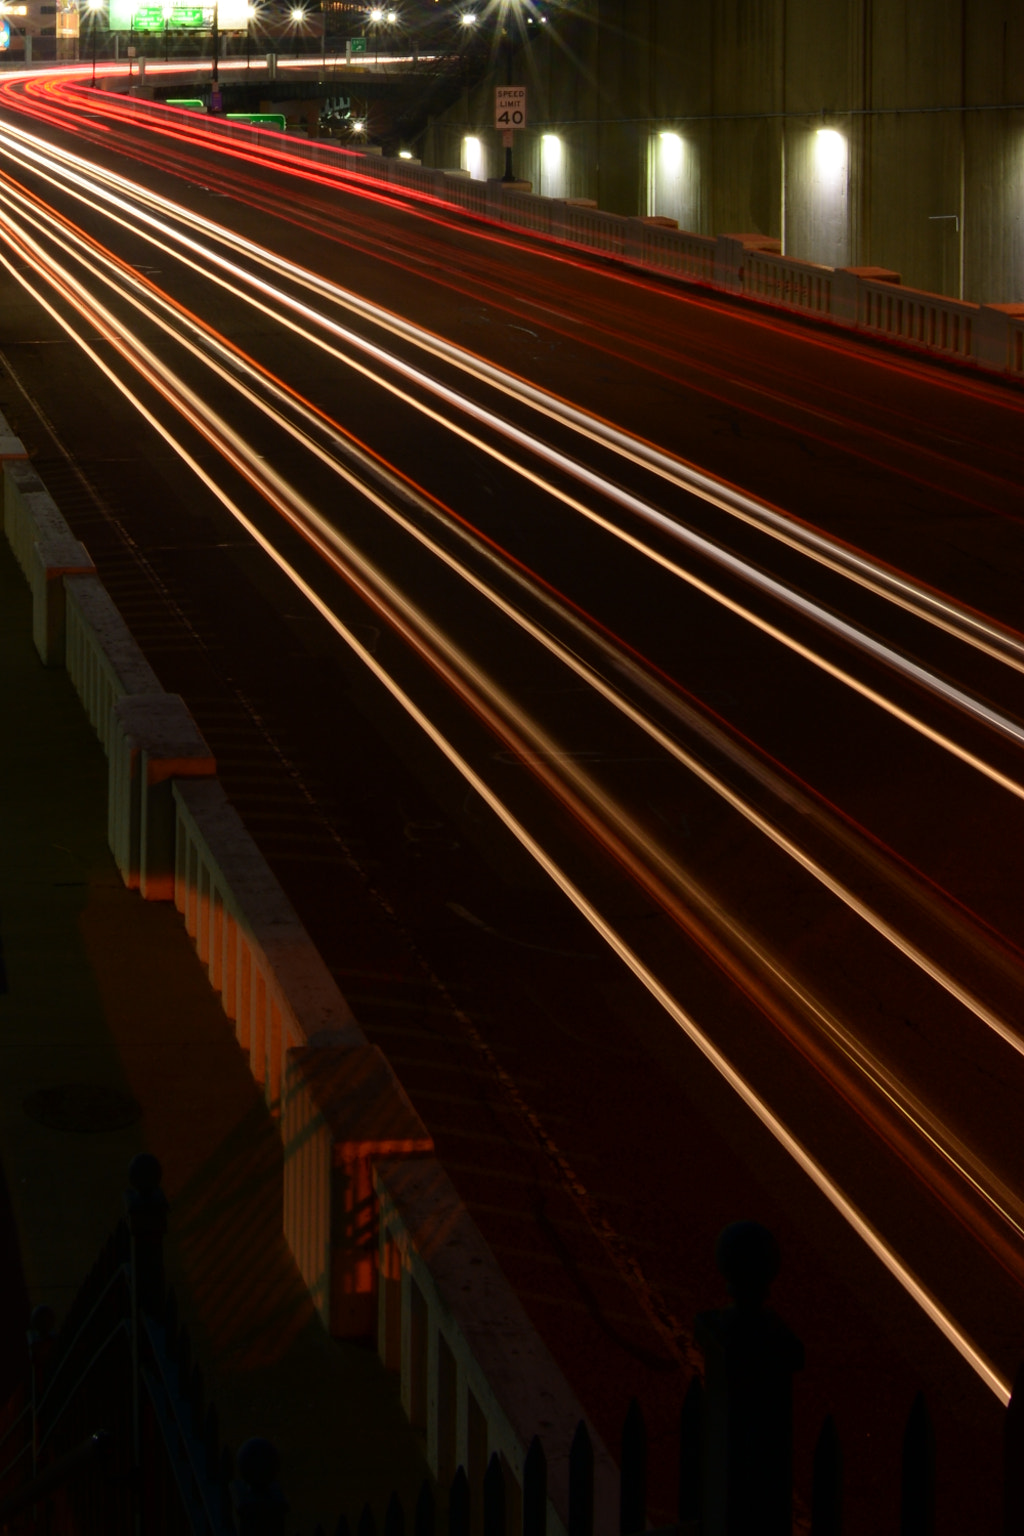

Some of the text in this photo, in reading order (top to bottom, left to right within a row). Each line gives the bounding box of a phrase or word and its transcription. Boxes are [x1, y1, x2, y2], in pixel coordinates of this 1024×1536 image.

[497, 90, 524, 98] SPEED
[499, 100, 521, 108] LIMIT
[497, 110, 524, 125] 40
